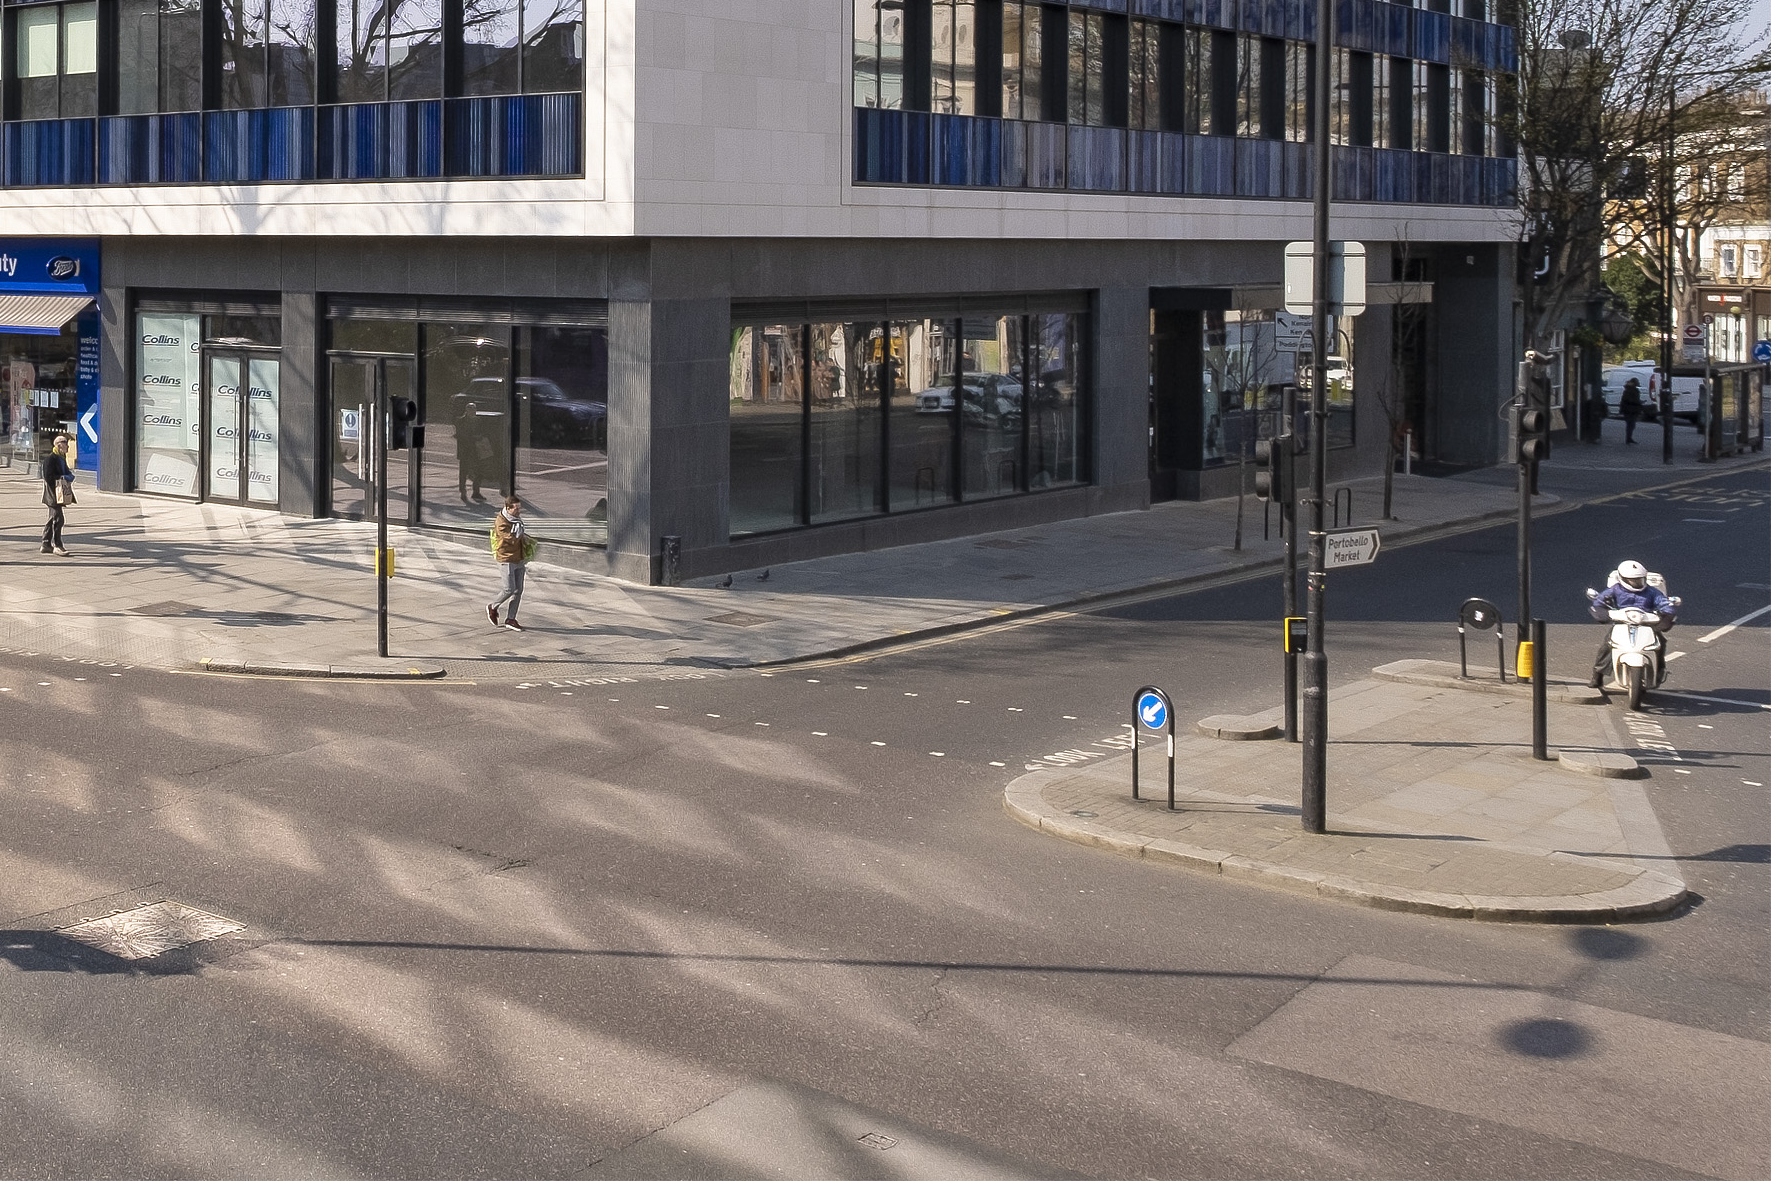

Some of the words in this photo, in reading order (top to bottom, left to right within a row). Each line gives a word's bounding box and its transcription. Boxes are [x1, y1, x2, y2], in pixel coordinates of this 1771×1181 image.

[50, 259, 75, 276] Boots
[142, 334, 180, 345] Collins
[142, 375, 181, 386] Collins
[143, 415, 182, 426] Collins
[143, 472, 186, 486] Collins
[1328, 535, 1369, 550] Portobello
[1333, 549, 1361, 563] Market
[1031, 748, 1106, 767] LOOK
